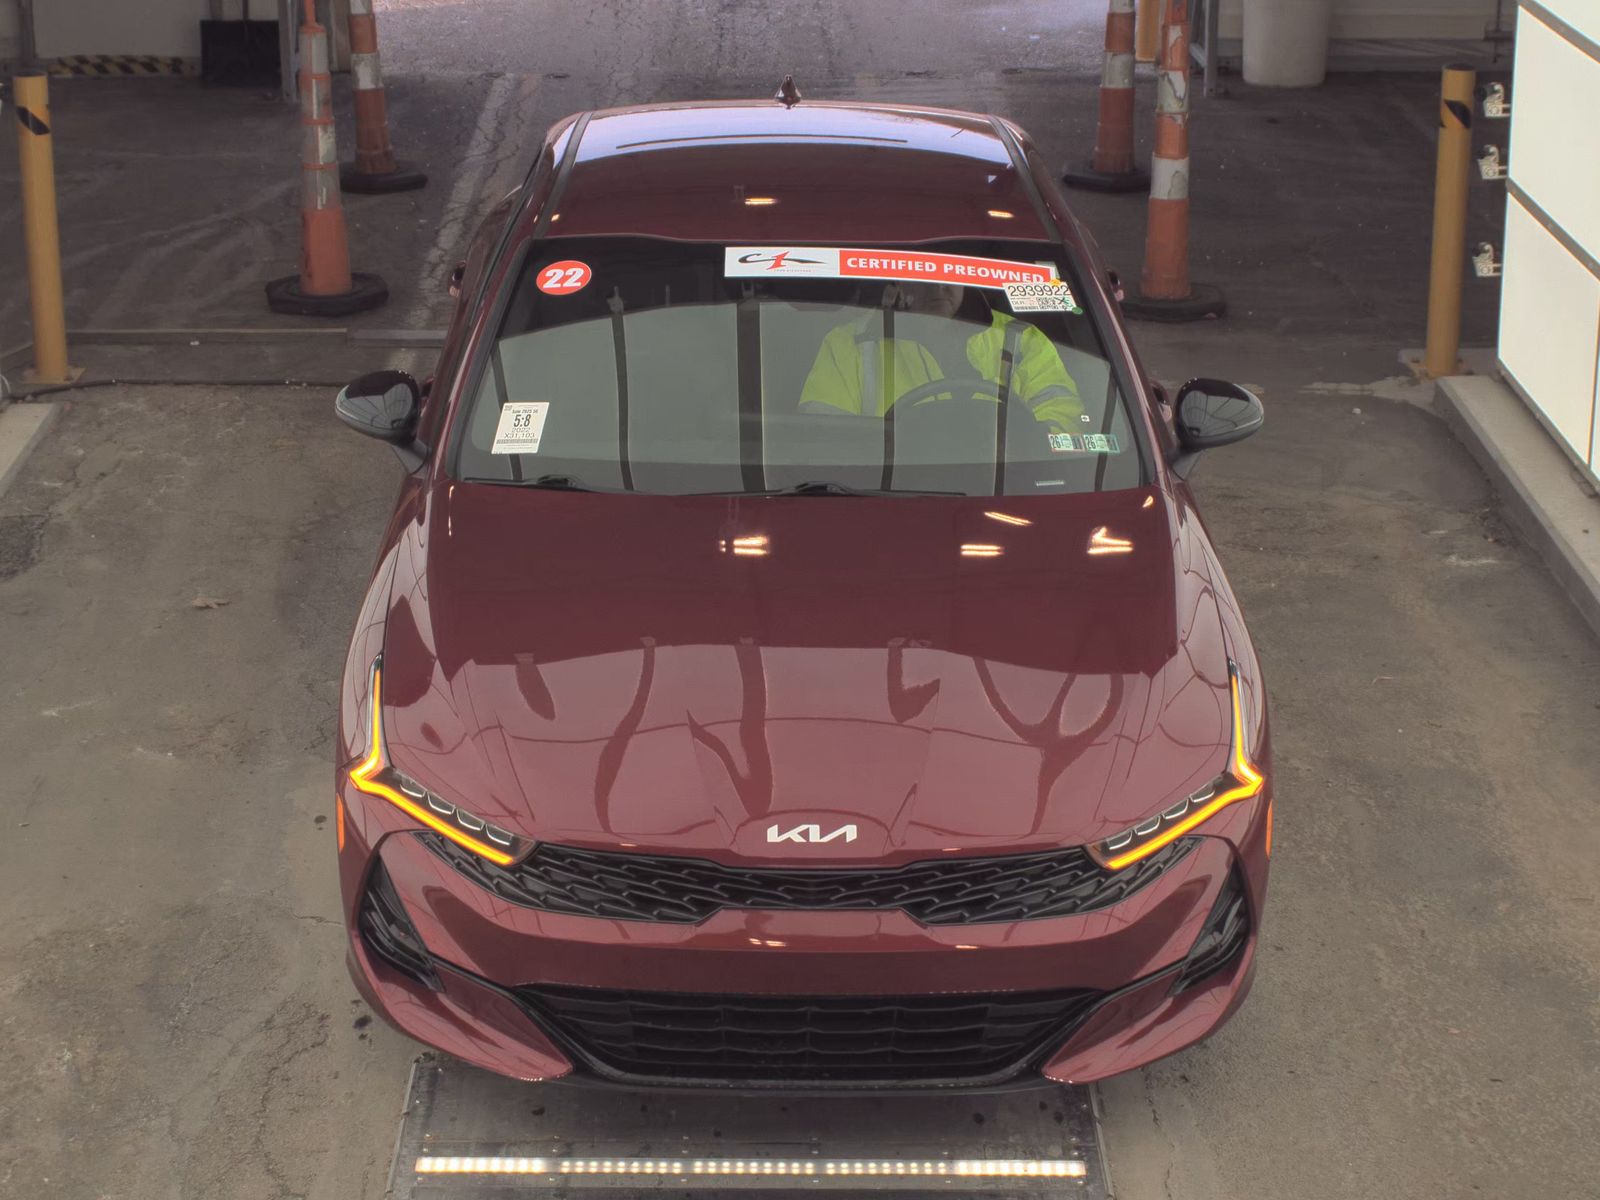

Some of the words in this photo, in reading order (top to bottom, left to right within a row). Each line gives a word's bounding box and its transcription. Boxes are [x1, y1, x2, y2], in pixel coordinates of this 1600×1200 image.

[847, 257, 937, 272] CERTIFIED
[943, 263, 1044, 282] PREOWNED
[543, 268, 584, 288] 22
[1008, 284, 1072, 297] 2939922
[513, 414, 532, 427] 5:8
[1050, 435, 1061, 448] 26
[1085, 436, 1096, 449] 26
[767, 824, 857, 843] KIA
